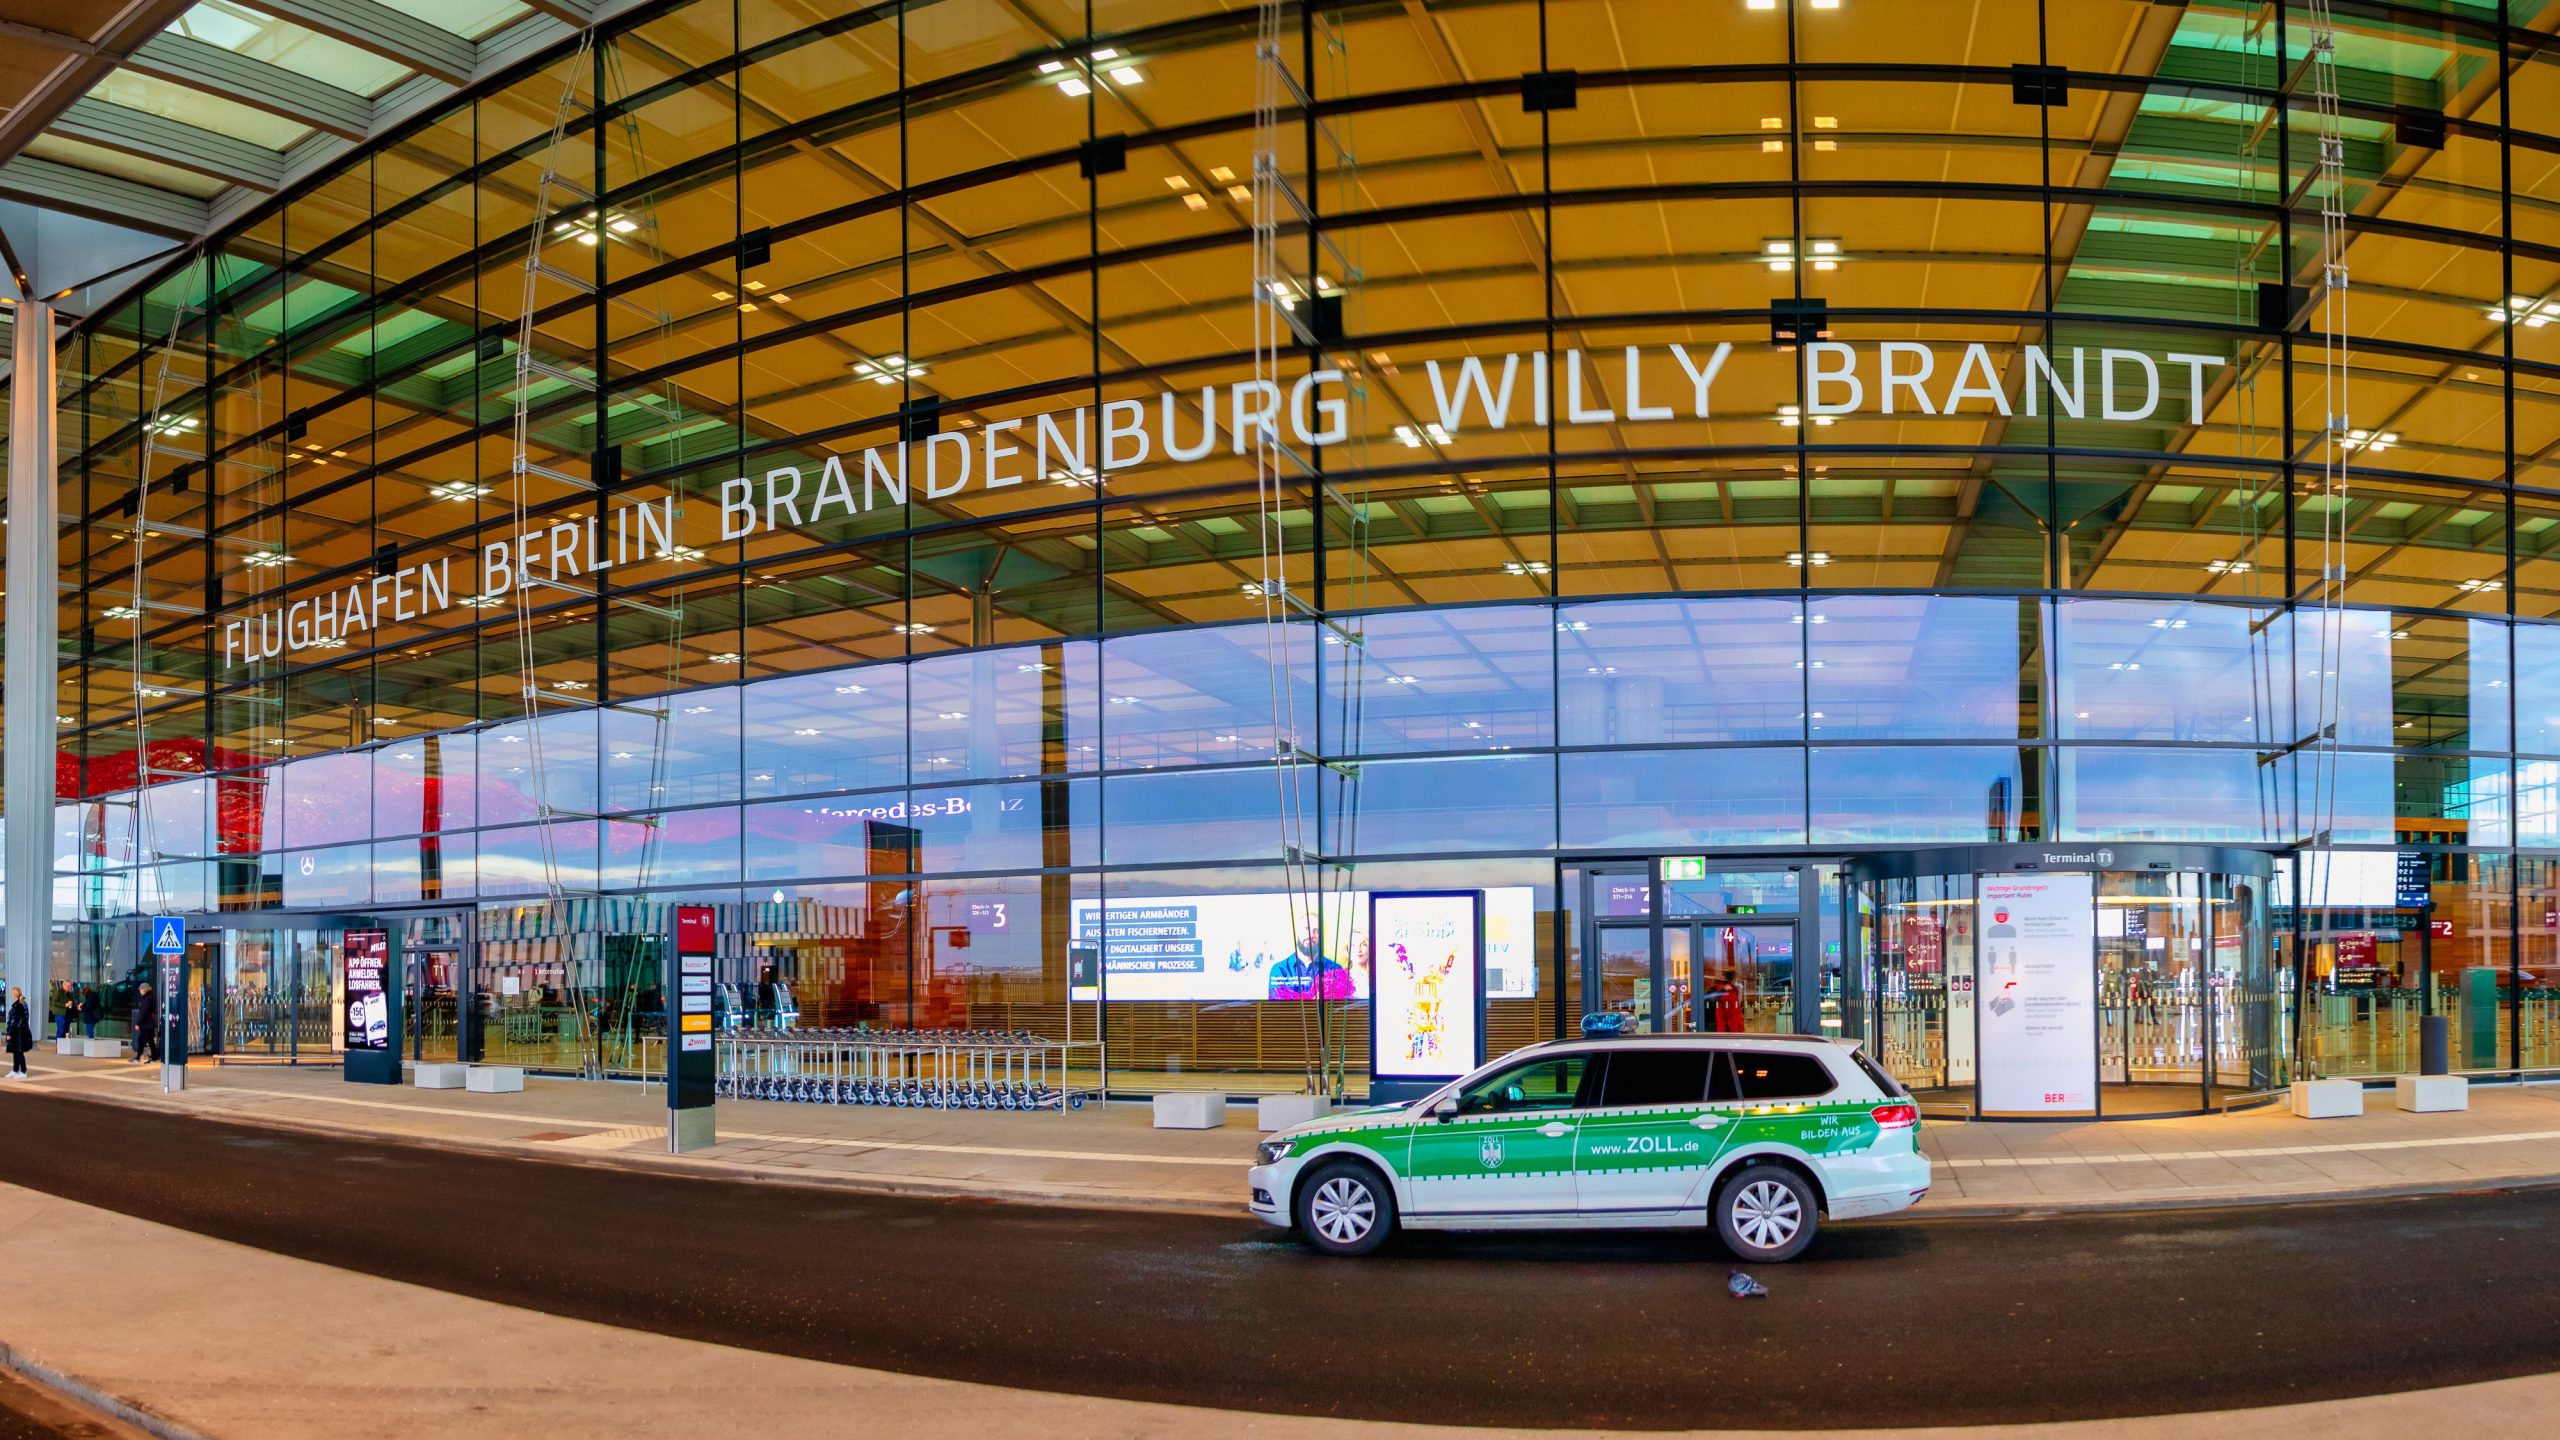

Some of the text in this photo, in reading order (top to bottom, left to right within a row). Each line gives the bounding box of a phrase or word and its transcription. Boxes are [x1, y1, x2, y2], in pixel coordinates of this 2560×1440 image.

[226, 341, 2225, 669] FLUGHAFEN BERLIN BRANDENBURG WILLY BRANDT
[2043, 853, 2112, 863] Terminal T1
[993, 904, 1006, 928] 3
[1085, 908, 1190, 921] WIR ERTIGEN ARMBÄNDER
[1085, 928, 1101, 937] AUS
[1103, 927, 1126, 936] LTEN
[2443, 921, 2452, 935] 2
[1724, 928, 1734, 942] 4
[1110, 944, 1163, 953] DIGITALISIERT
[1165, 944, 1195, 953] UNSERE
[349, 955, 383, 968] APP ÖFFNEN.
[1157, 961, 1198, 970] PROZESSE.
[349, 969, 380, 979] ANMELDEN.
[434, 965, 444, 977] T1
[349, 979, 382, 990] LOSFAHREN.
[2045, 1093, 2065, 1103] BER
[1820, 1115, 1839, 1126] WIR
[1801, 1125, 1861, 1140] BILDEN AUS
[1591, 1136, 1699, 1155] www.ZOLL.de
